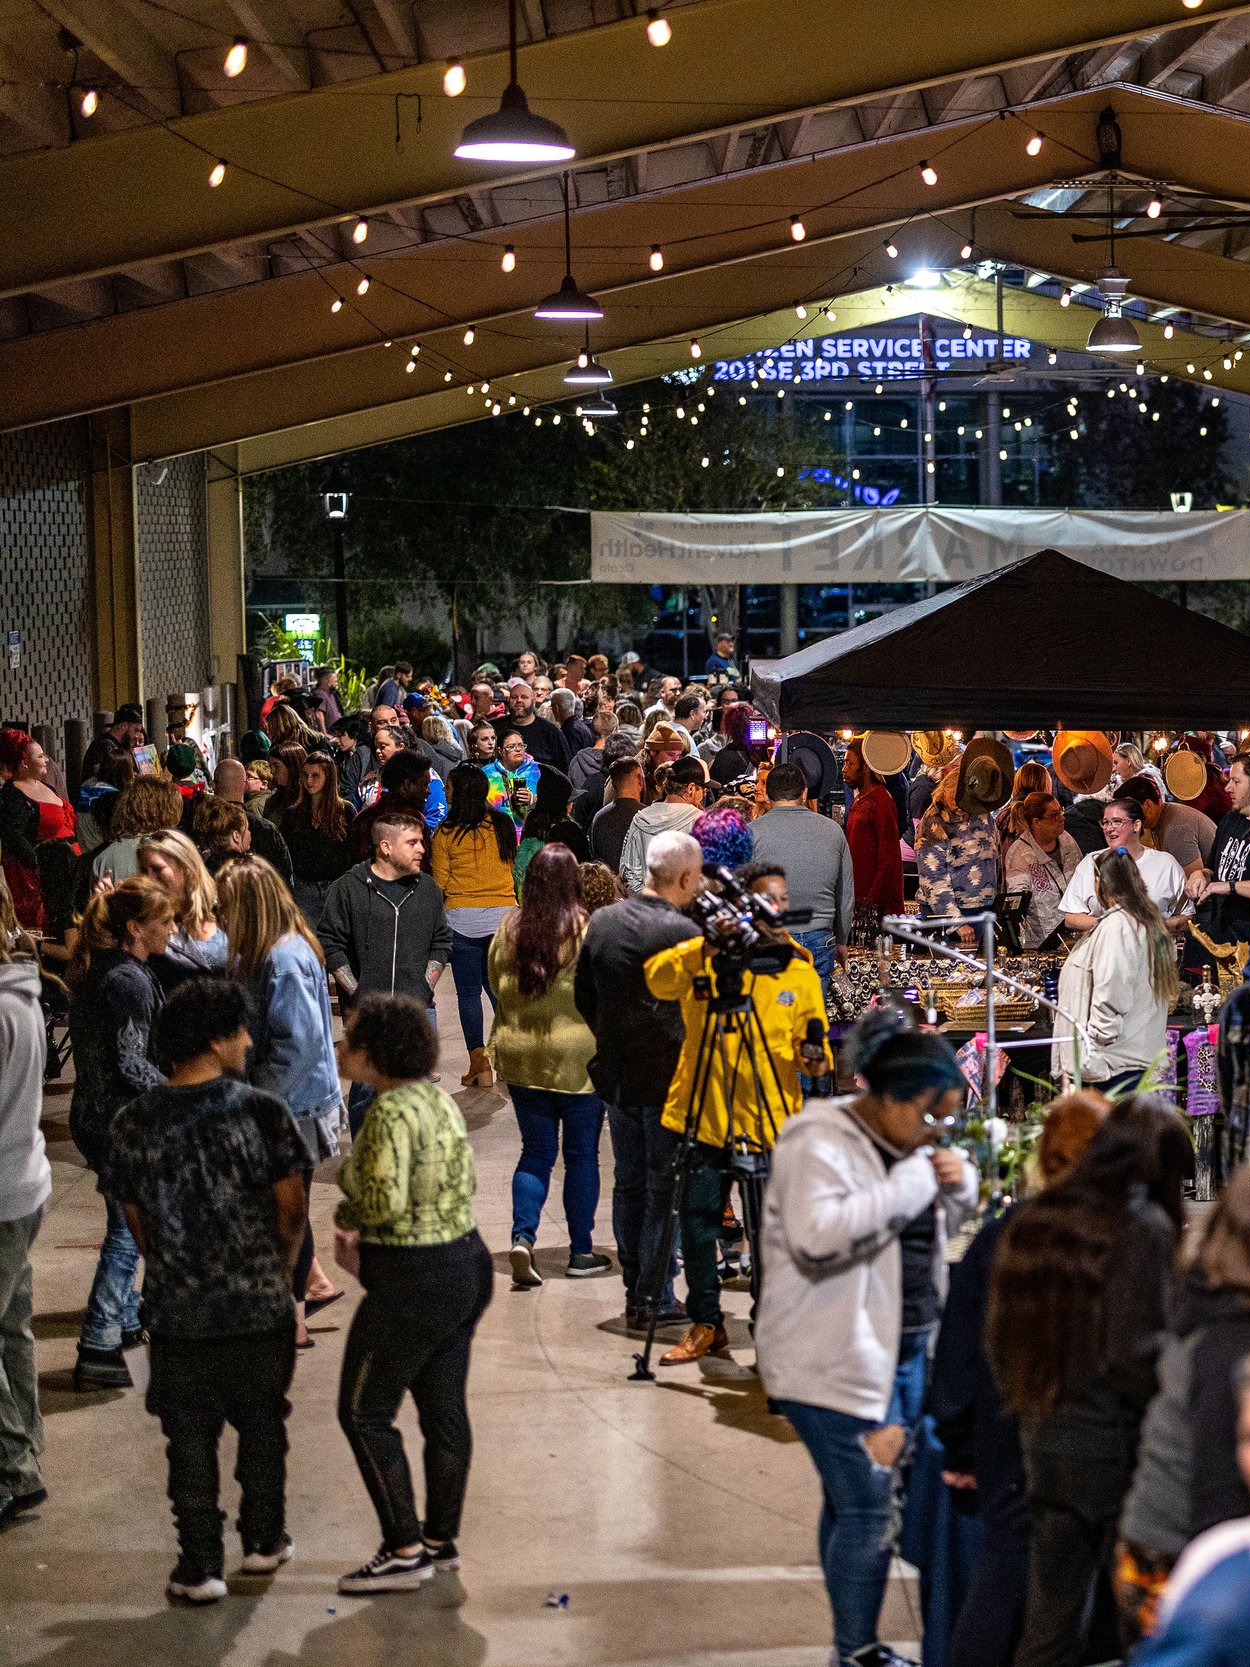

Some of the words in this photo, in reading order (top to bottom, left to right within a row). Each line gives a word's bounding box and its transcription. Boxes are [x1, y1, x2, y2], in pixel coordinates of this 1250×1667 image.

[821, 338, 923, 359] SERVICE
[934, 338, 1032, 359] CENTER
[761, 360, 795, 381] SE
[799, 360, 850, 381] 3RD
